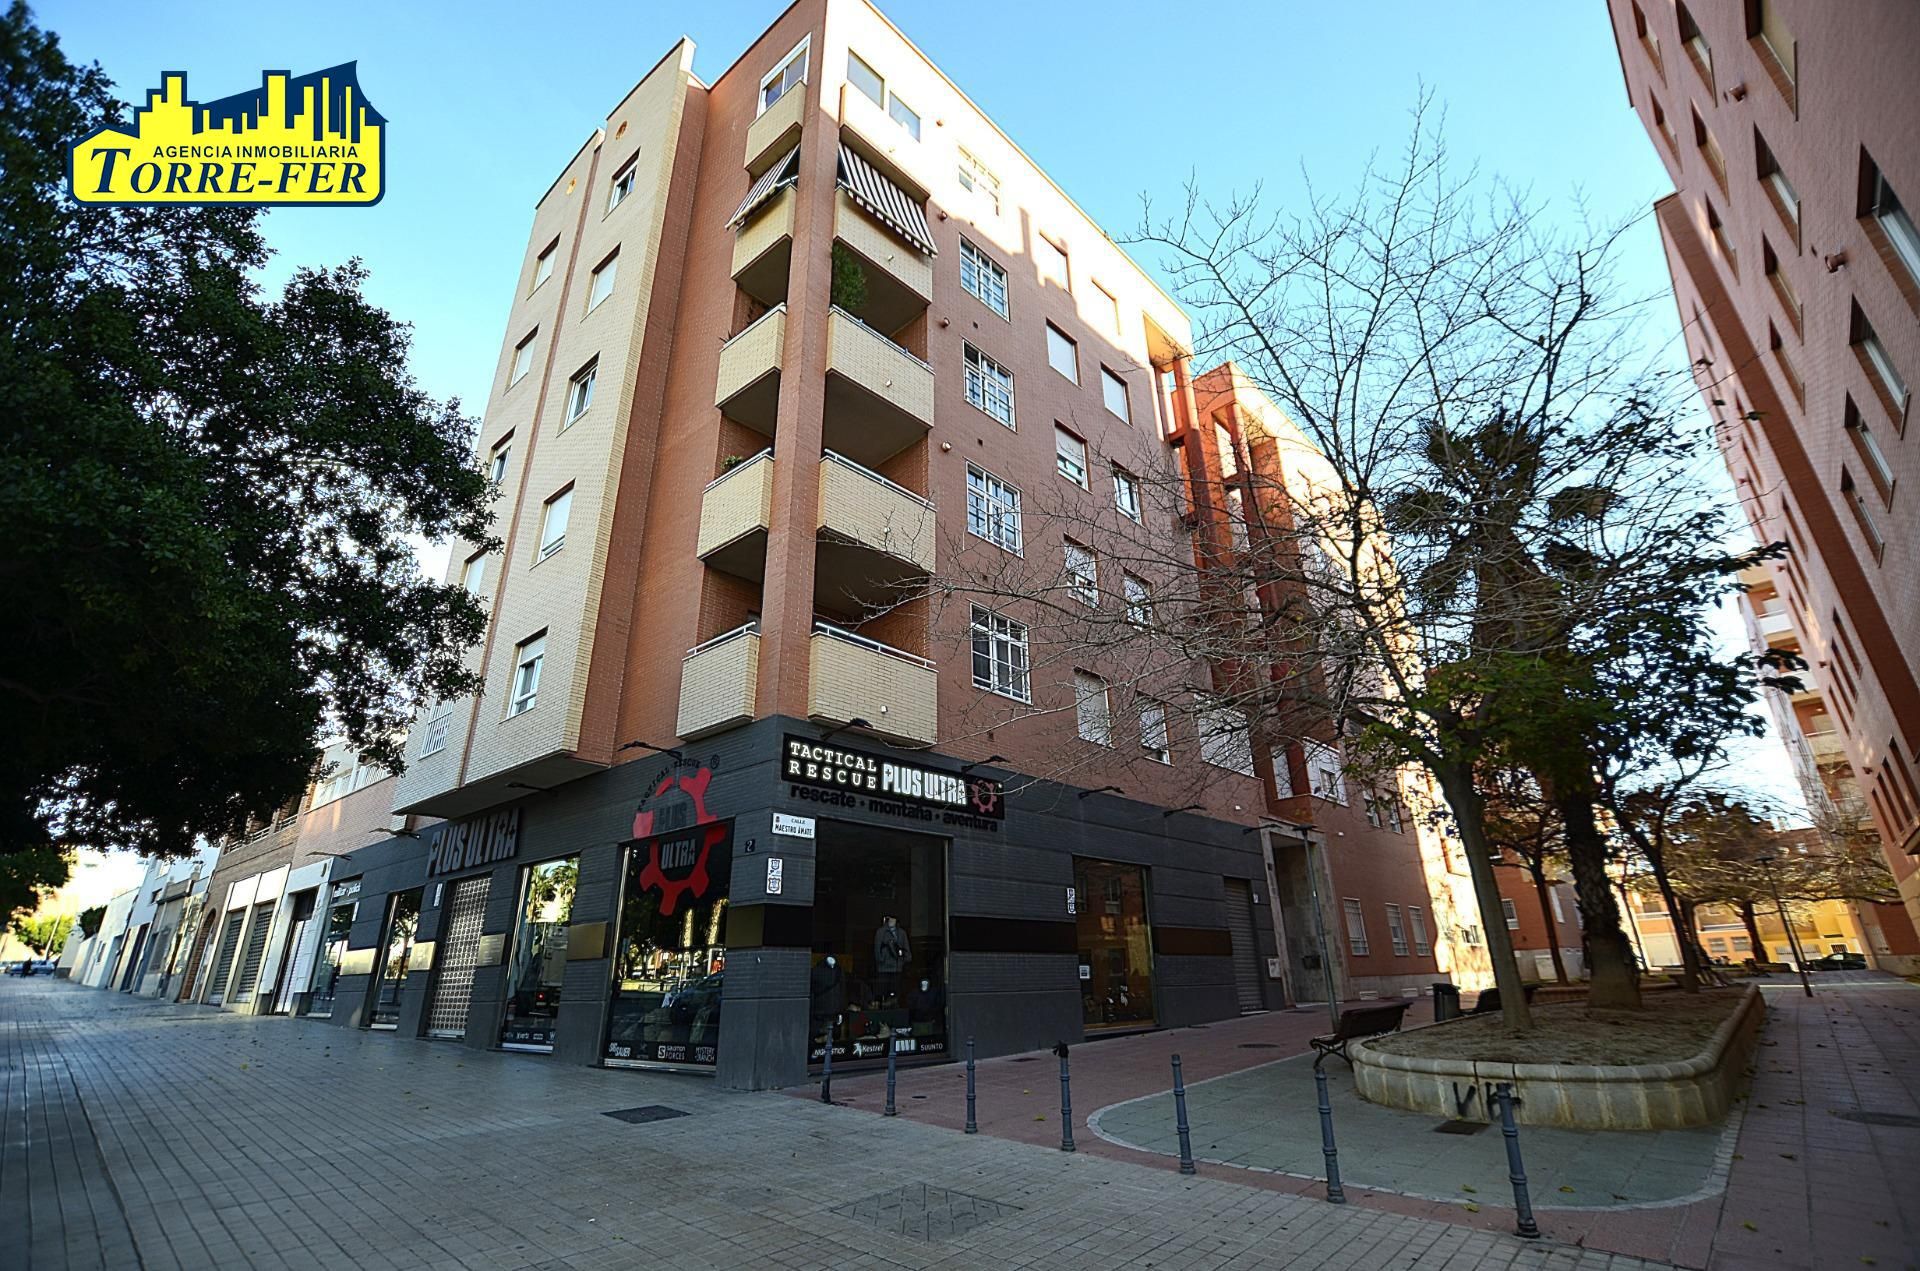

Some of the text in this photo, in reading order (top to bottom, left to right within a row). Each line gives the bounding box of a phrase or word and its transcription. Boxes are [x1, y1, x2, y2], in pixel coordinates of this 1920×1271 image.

[789, 741, 878, 773] TACTICAL
[788, 759, 877, 790] RESCUE
[882, 763, 967, 806] PLUS ULTRA
[790, 784, 999, 833] rescate montaña aventura
[775, 823, 797, 834] MAESTRO
[424, 807, 520, 878] PLUS ULTRA
[746, 840, 753, 852] 2
[660, 839, 697, 870] ULTRA
[665, 1051, 686, 1061] FORCES
[695, 1046, 715, 1055] MYSTERY
[862, 1042, 884, 1053] Kestrel
[920, 1043, 944, 1052] SUUNTO
